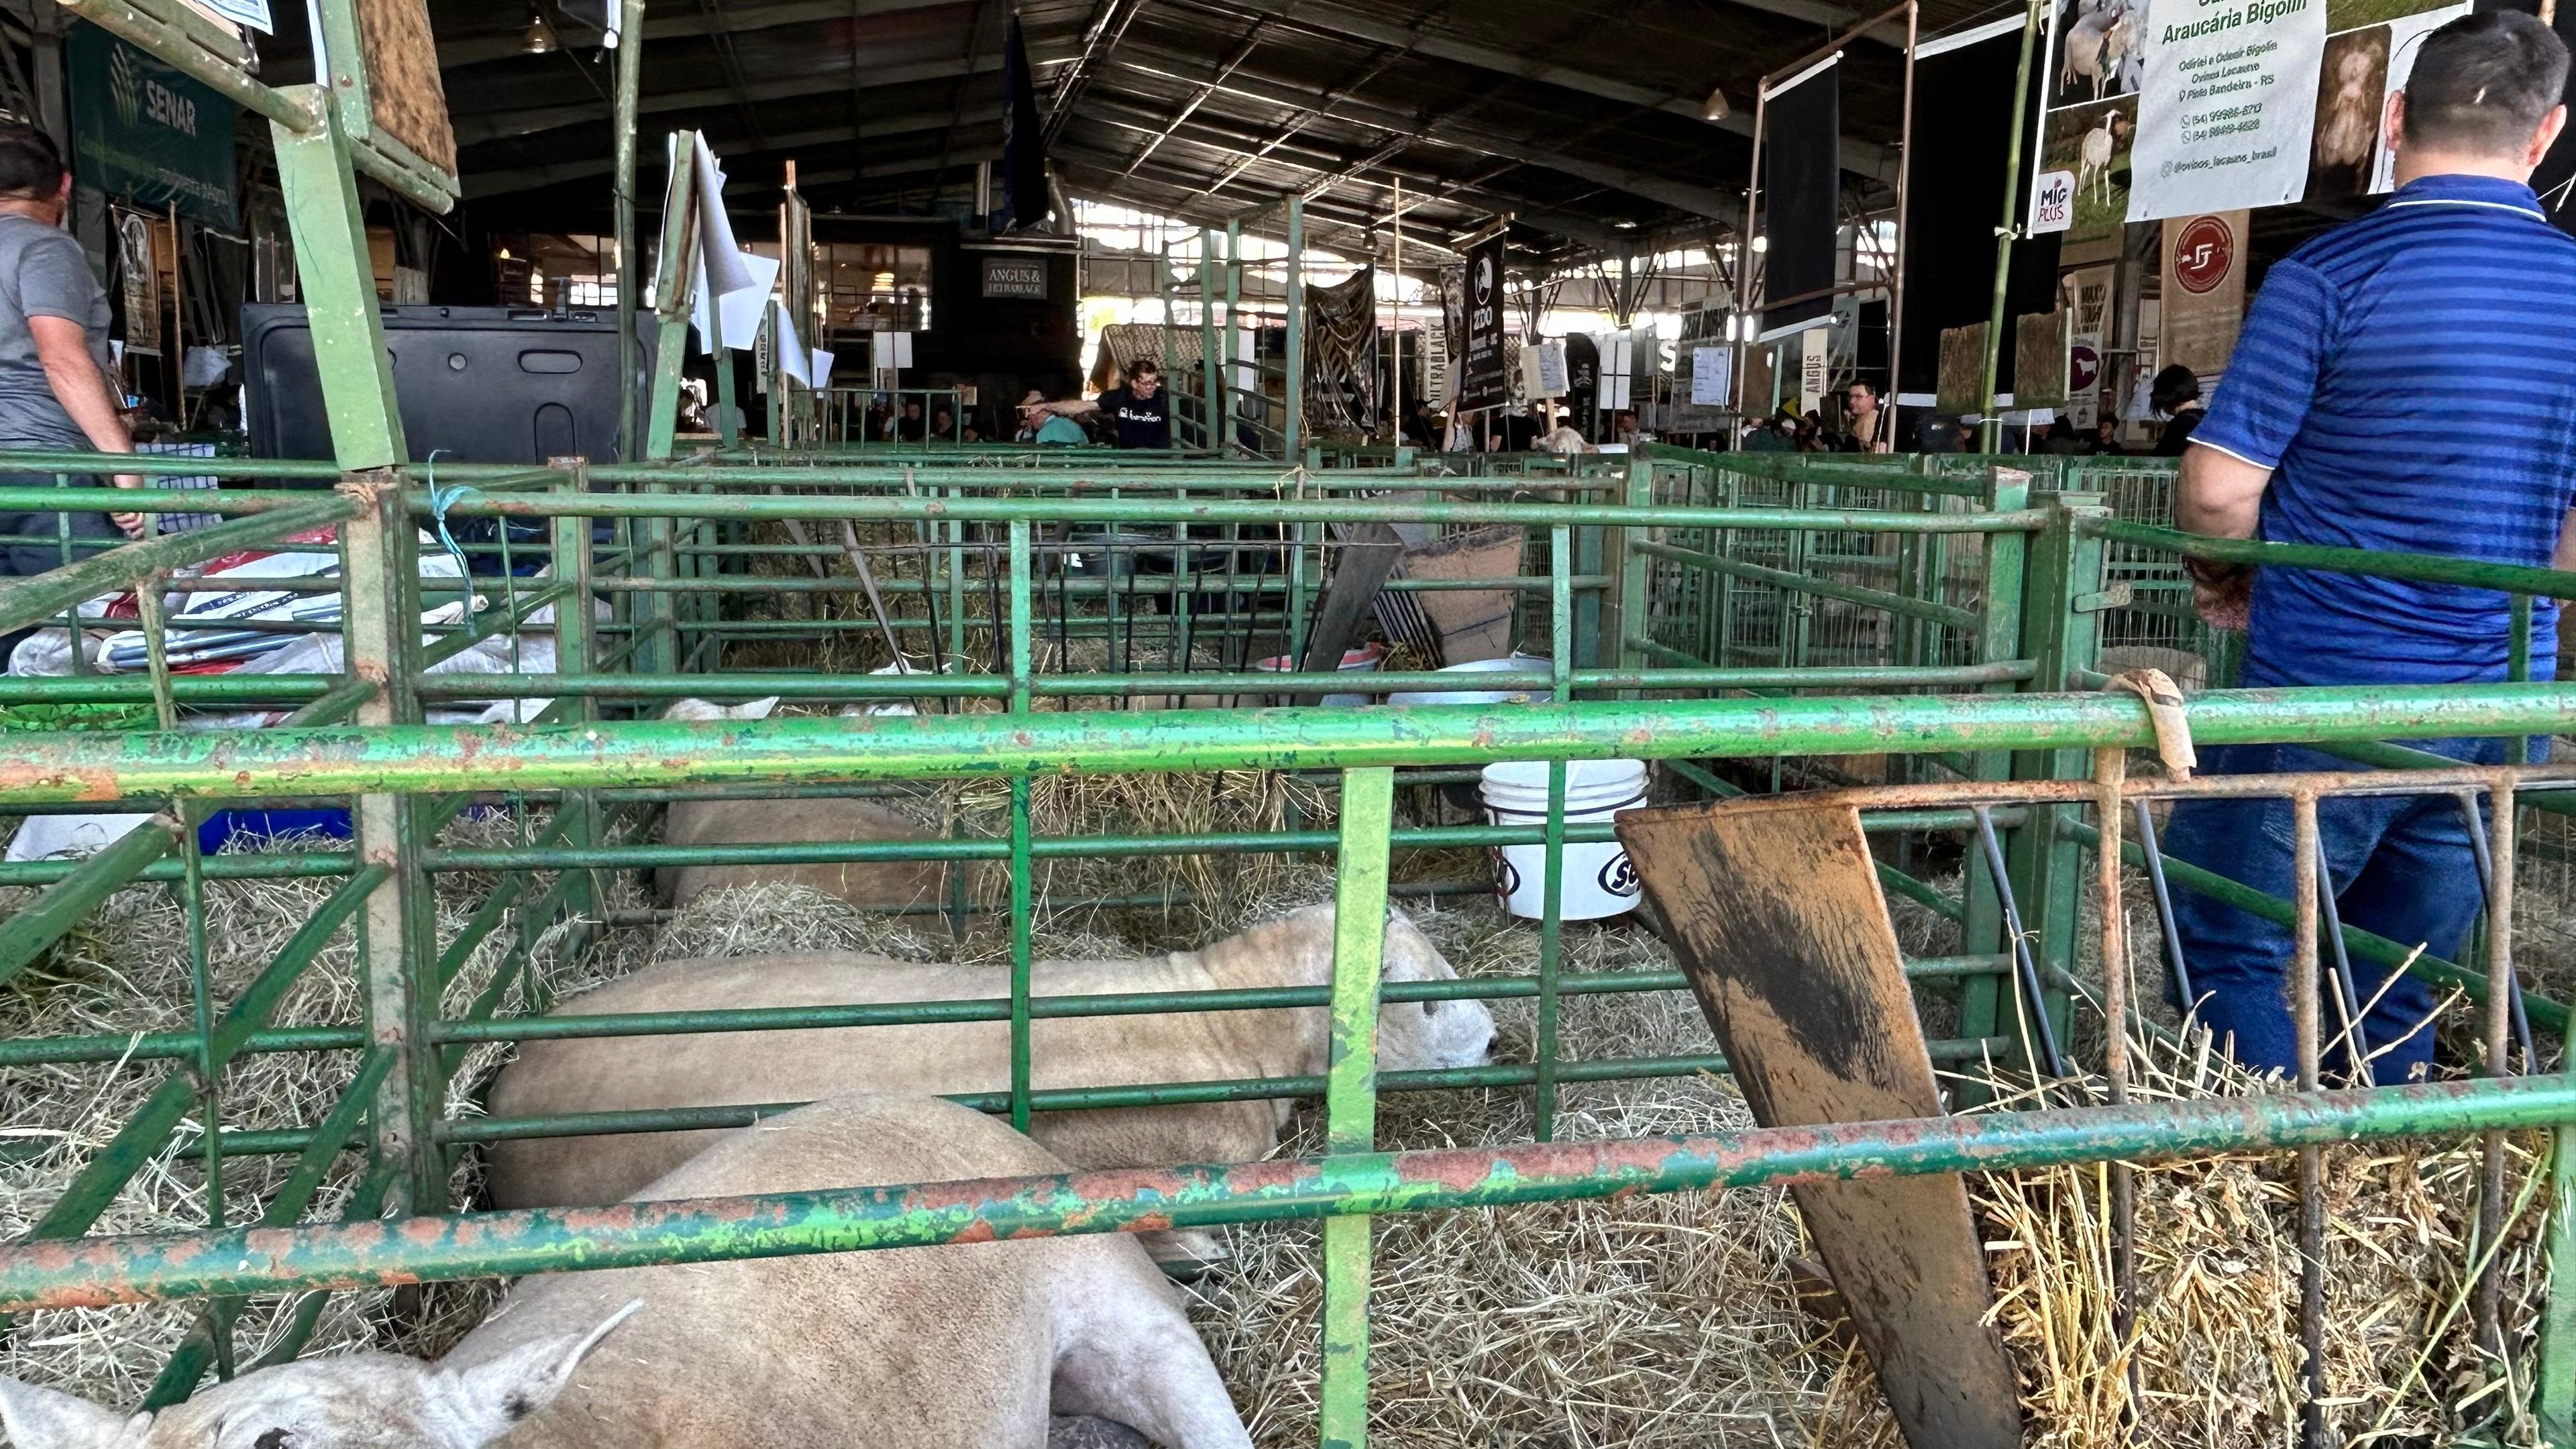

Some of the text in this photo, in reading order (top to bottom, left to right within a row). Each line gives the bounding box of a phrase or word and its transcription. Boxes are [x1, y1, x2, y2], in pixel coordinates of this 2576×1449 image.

[2162, 7, 2242, 45] Araucária
[2209, 80, 2252, 96] Bandeira
[2260, 74, 2274, 86] RS
[146, 80, 196, 137] SENAR
[2038, 204, 2063, 222] PLUS
[1805, 355, 1821, 393] ANGUS
